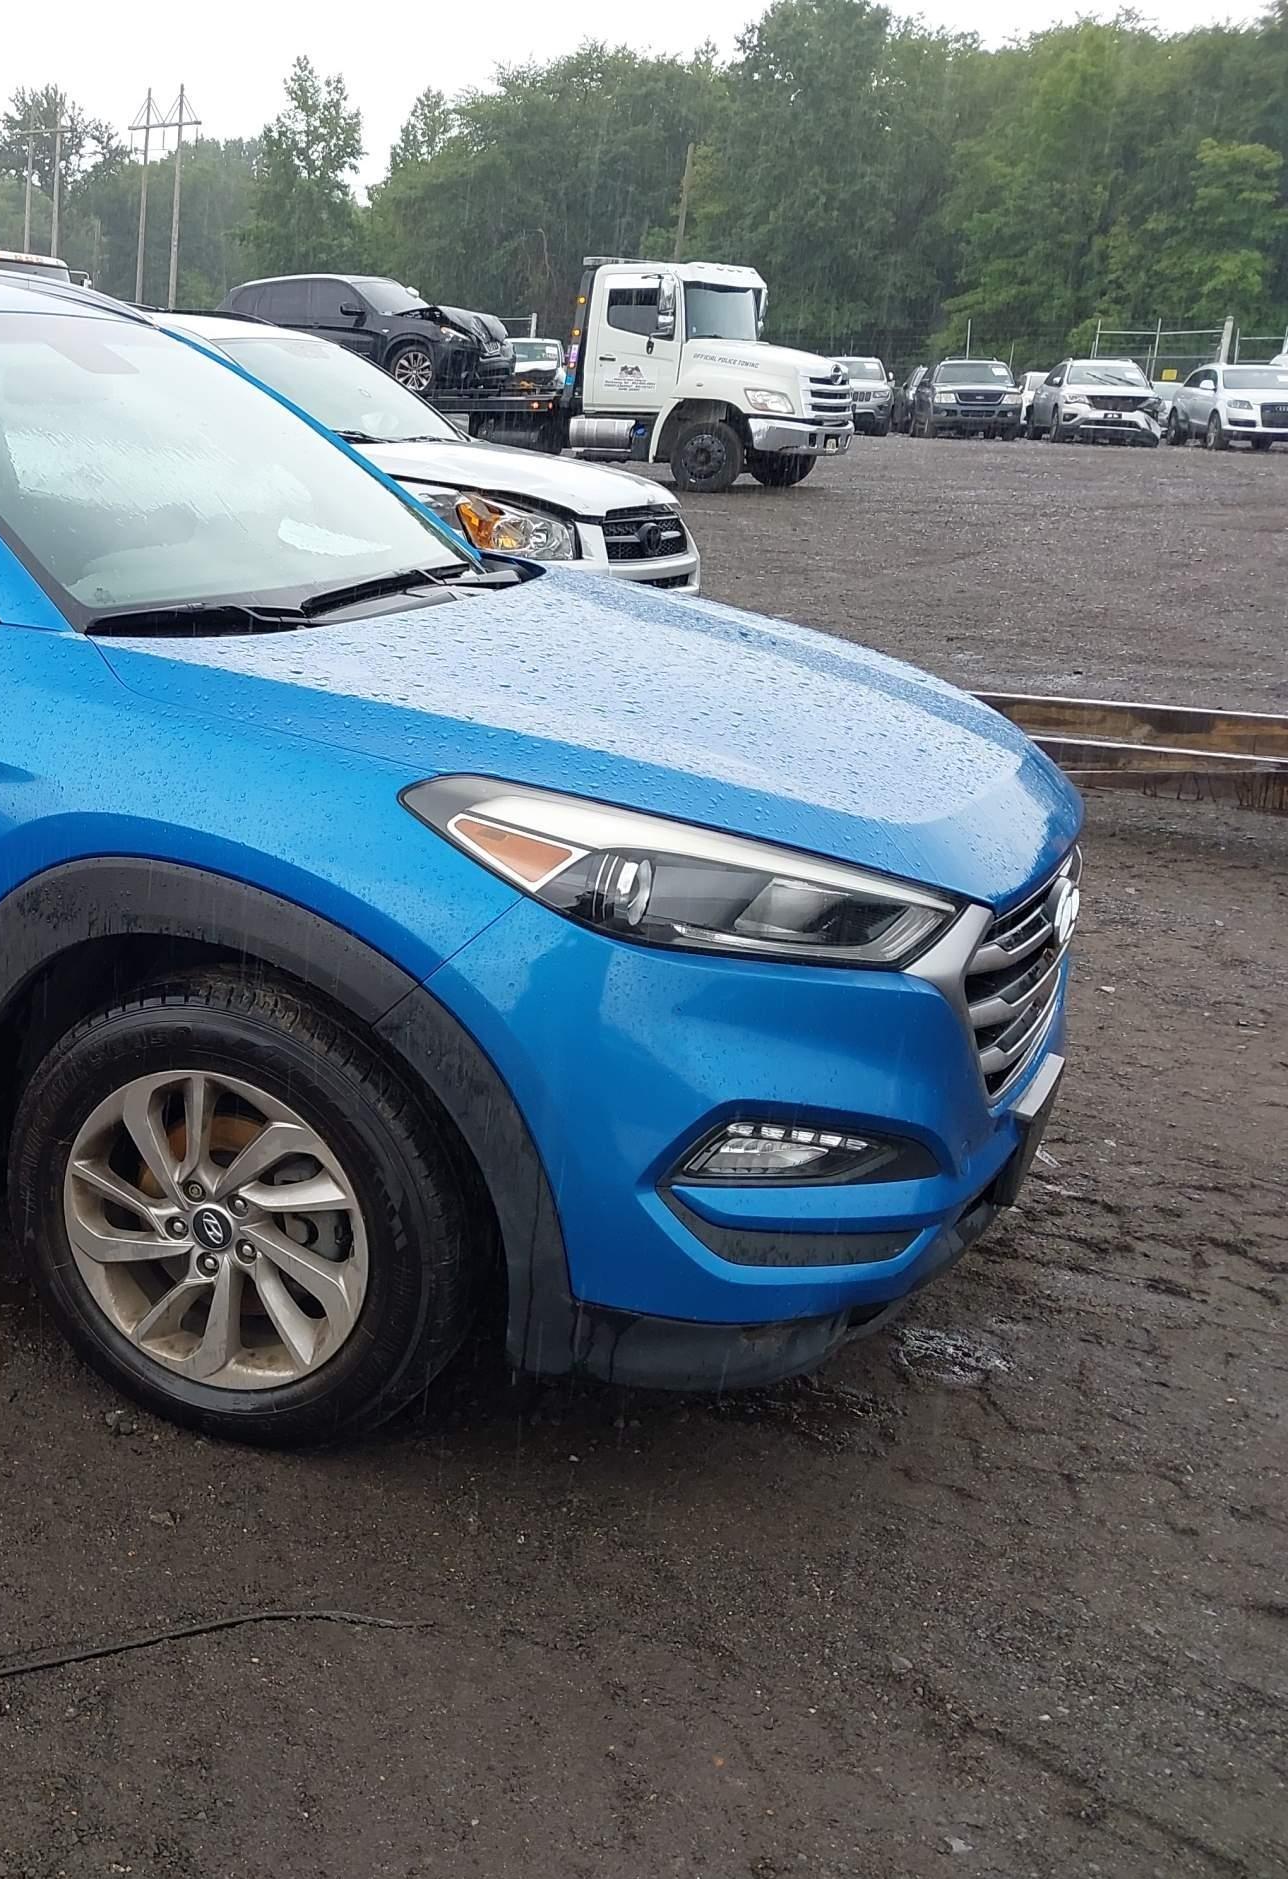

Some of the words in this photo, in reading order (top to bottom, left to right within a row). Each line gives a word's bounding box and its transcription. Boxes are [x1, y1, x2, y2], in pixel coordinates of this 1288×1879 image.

[692, 352, 717, 362] OFFICIAL
[717, 356, 738, 366] POLICE
[737, 359, 760, 369] TOWING
